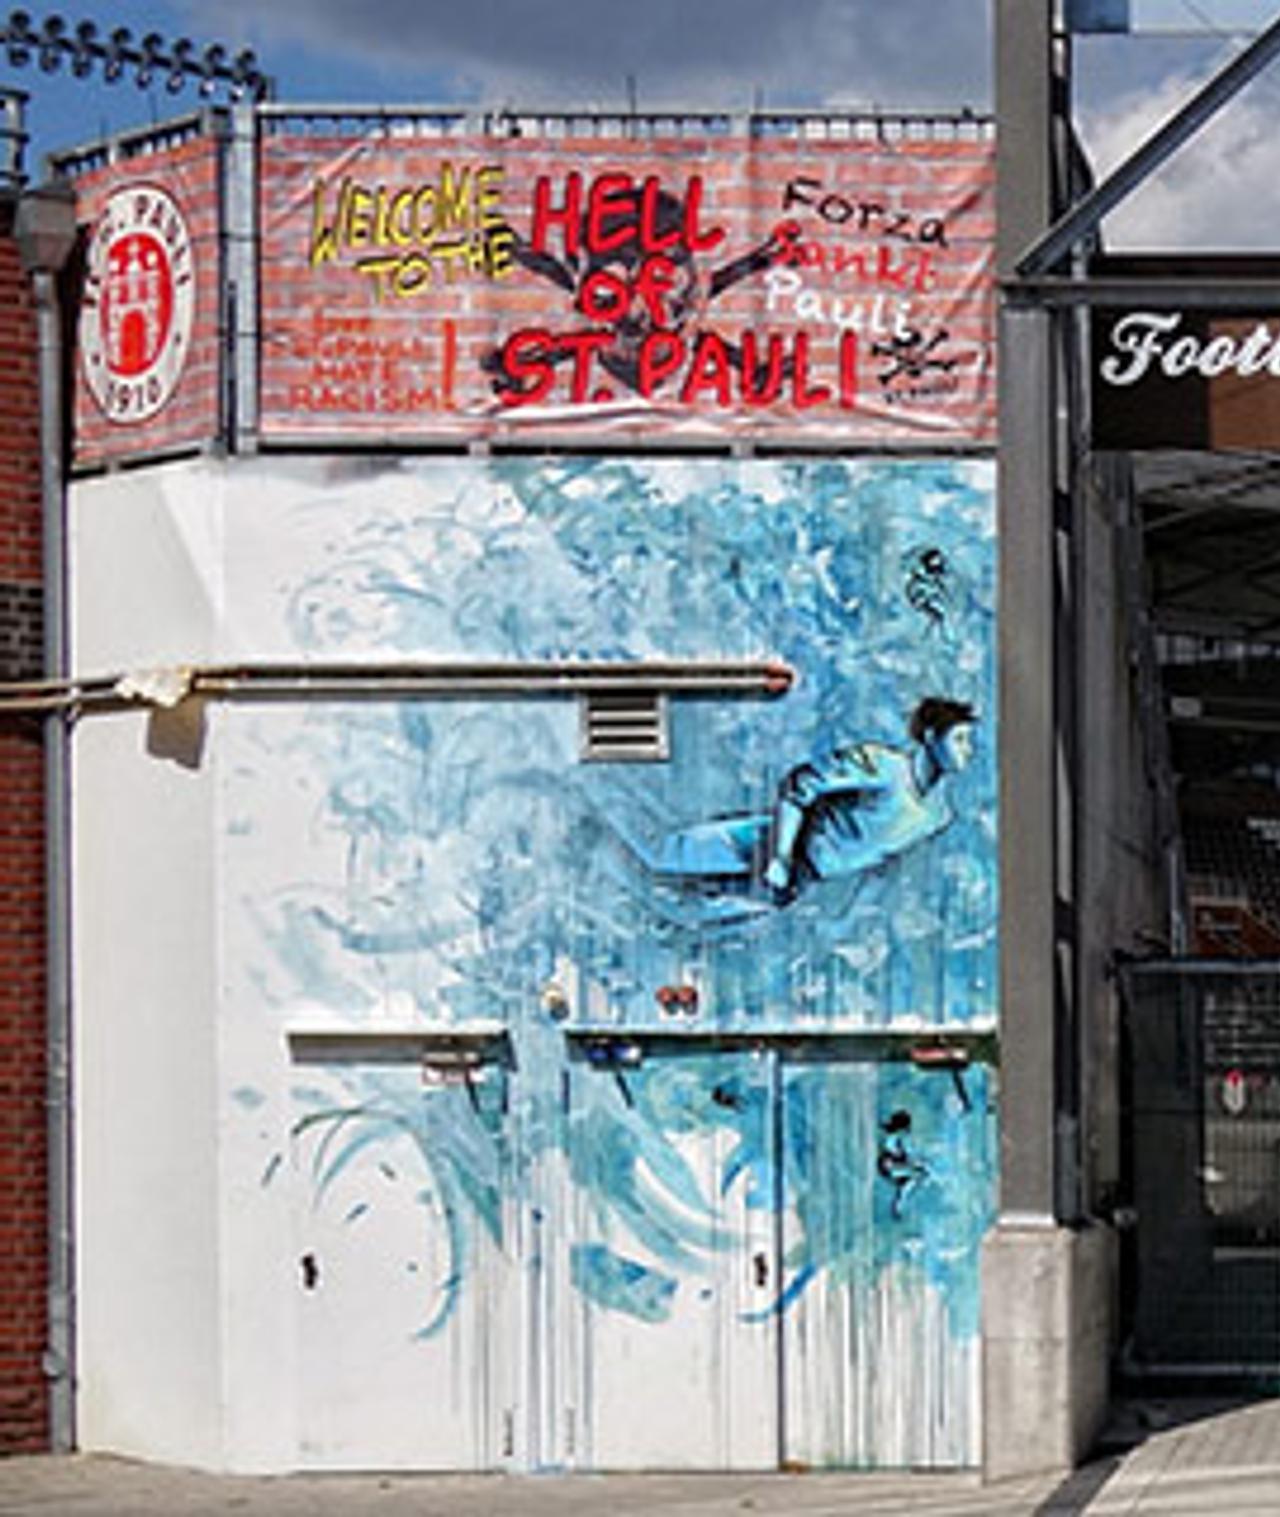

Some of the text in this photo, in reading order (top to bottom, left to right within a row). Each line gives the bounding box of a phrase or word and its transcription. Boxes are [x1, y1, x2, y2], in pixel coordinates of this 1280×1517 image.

[309, 161, 505, 268] WELCOME
[530, 171, 727, 256] HELL
[783, 177, 949, 248] Forza
[356, 232, 516, 300] TO THE
[578, 257, 677, 326] of
[773, 220, 938, 295] Sankt
[764, 267, 914, 340] Pauli
[105, 376, 160, 414] 1910
